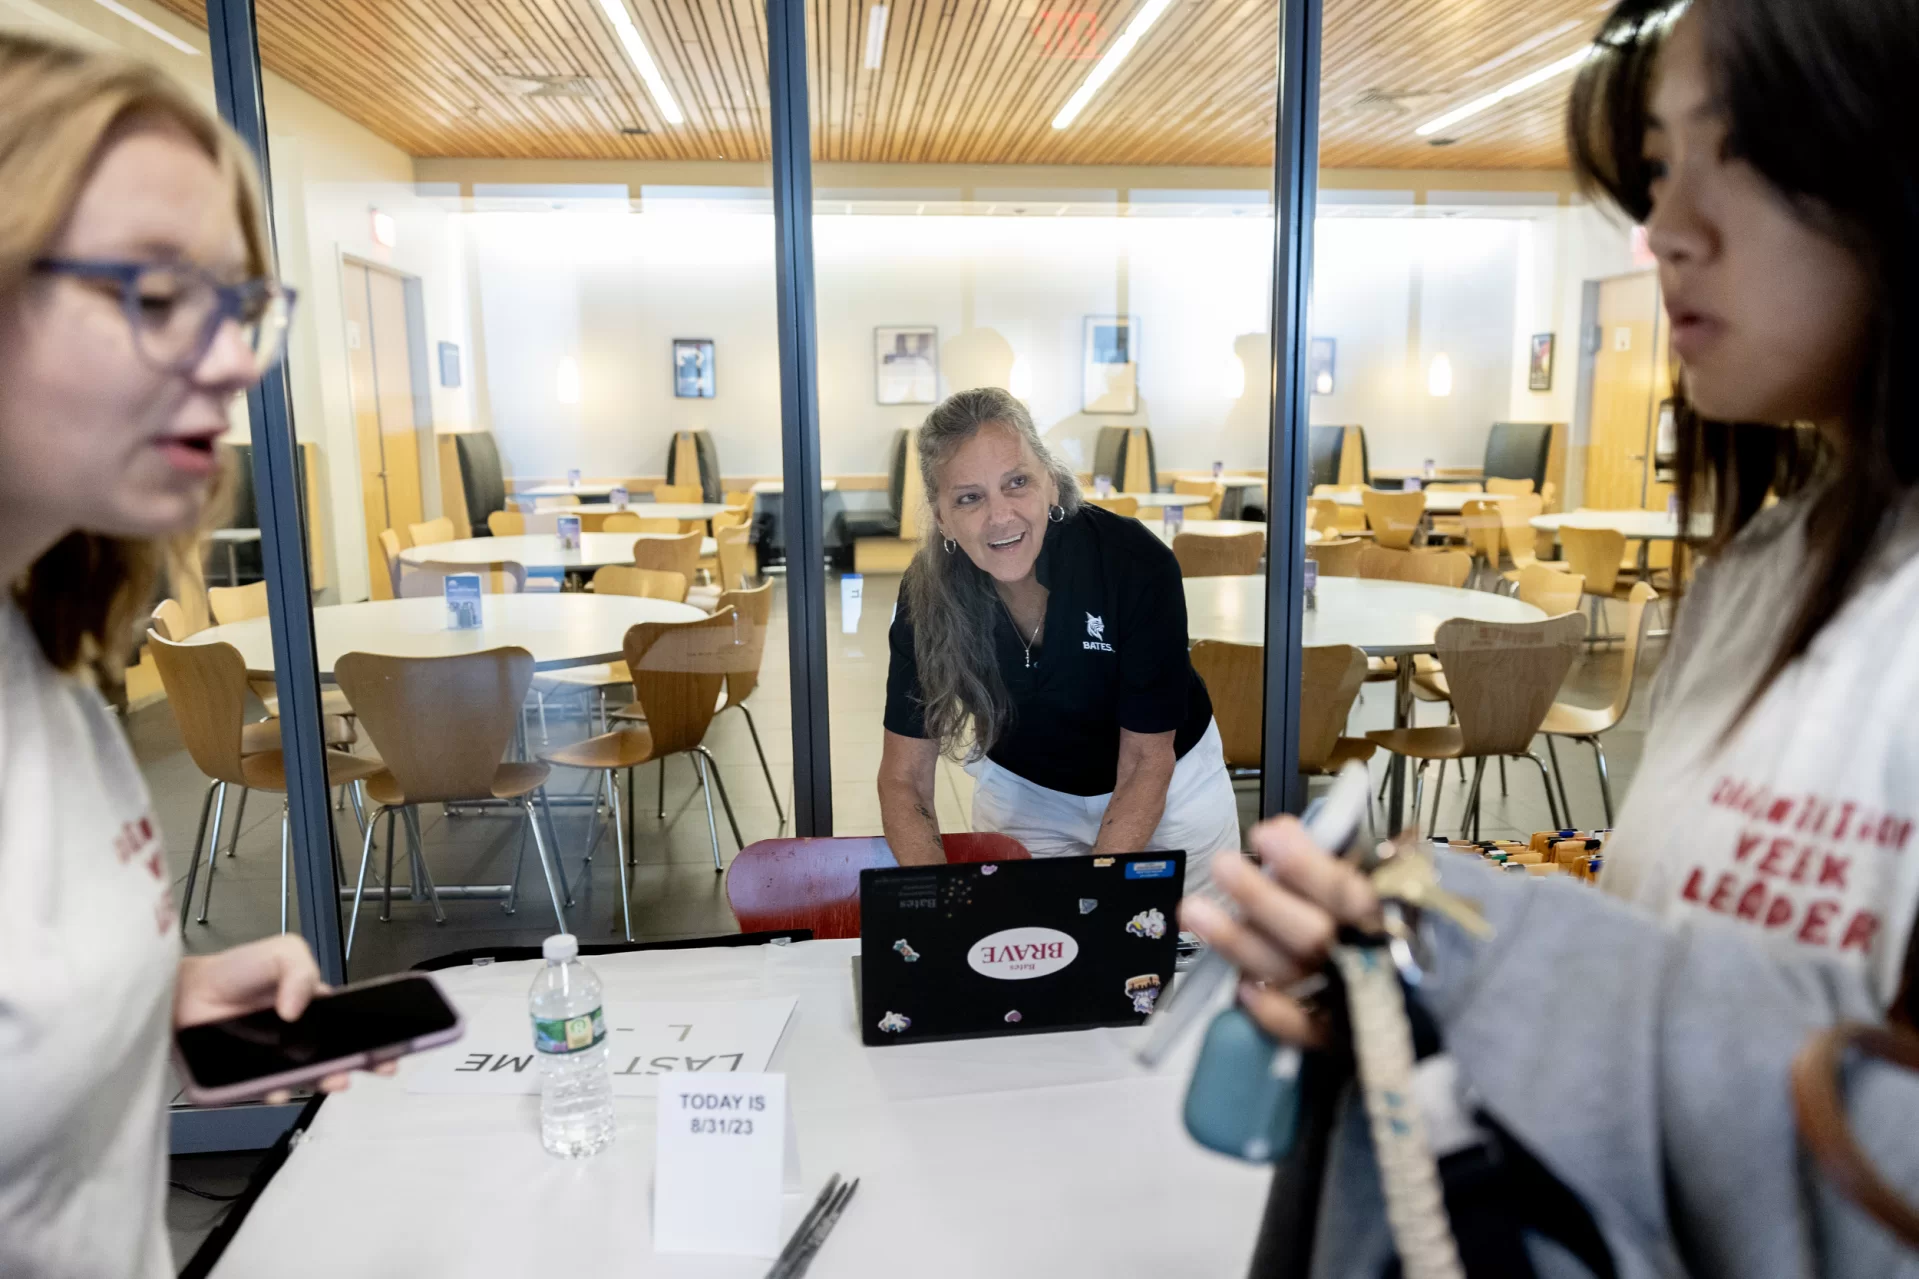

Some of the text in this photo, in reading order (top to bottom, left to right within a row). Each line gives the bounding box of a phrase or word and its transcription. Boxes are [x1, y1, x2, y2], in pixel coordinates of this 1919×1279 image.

[1083, 641, 1113, 652] BATES
[1682, 866, 1881, 954] LEADER
[981, 942, 1064, 964] BRAVE
[1009, 963, 1036, 971] Bates
[668, 1024, 693, 1041] L
[613, 1053, 744, 1074] LAST
[680, 1093, 766, 1111] TODAY IS
[690, 1118, 754, 1135] 8/31/23
